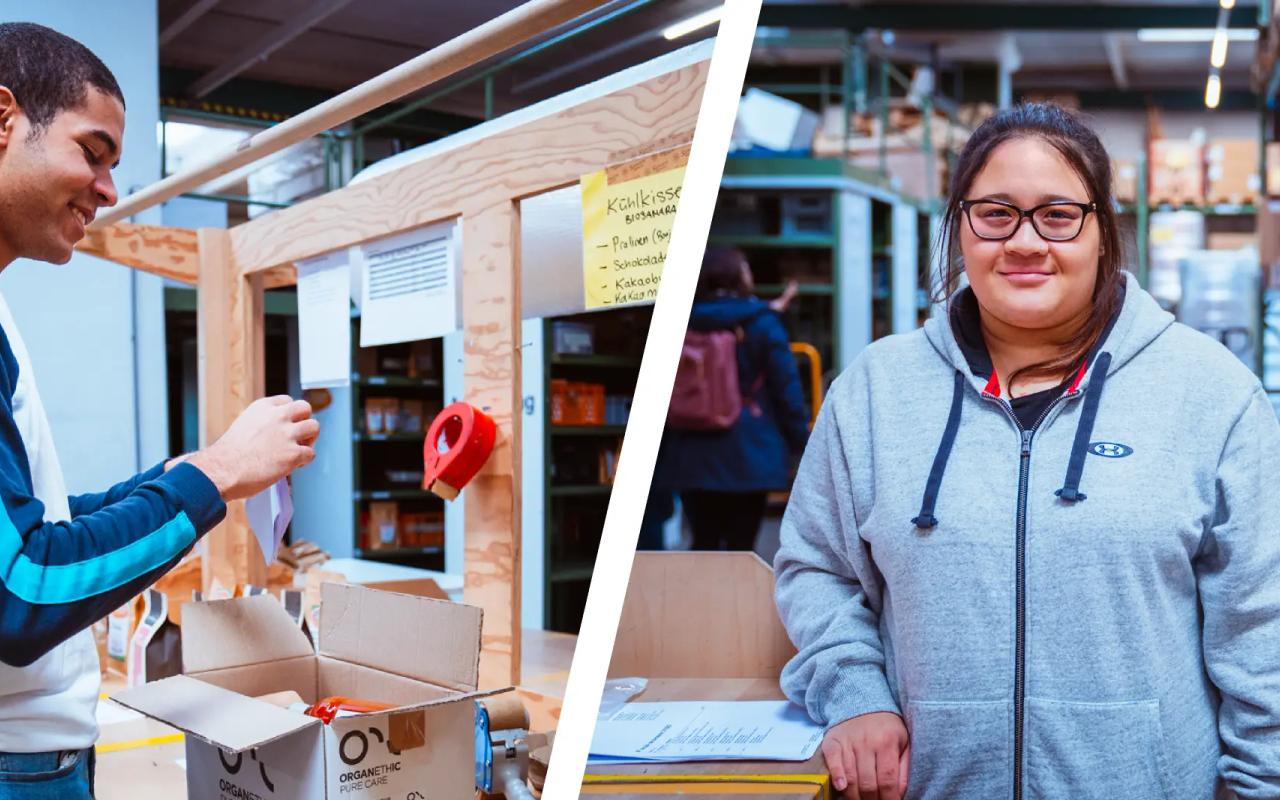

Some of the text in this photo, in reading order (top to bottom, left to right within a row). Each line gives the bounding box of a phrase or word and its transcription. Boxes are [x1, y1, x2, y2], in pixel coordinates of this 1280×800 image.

[339, 761, 401, 783] ORGANETHIC
[340, 775, 388, 794] PURE CARE
